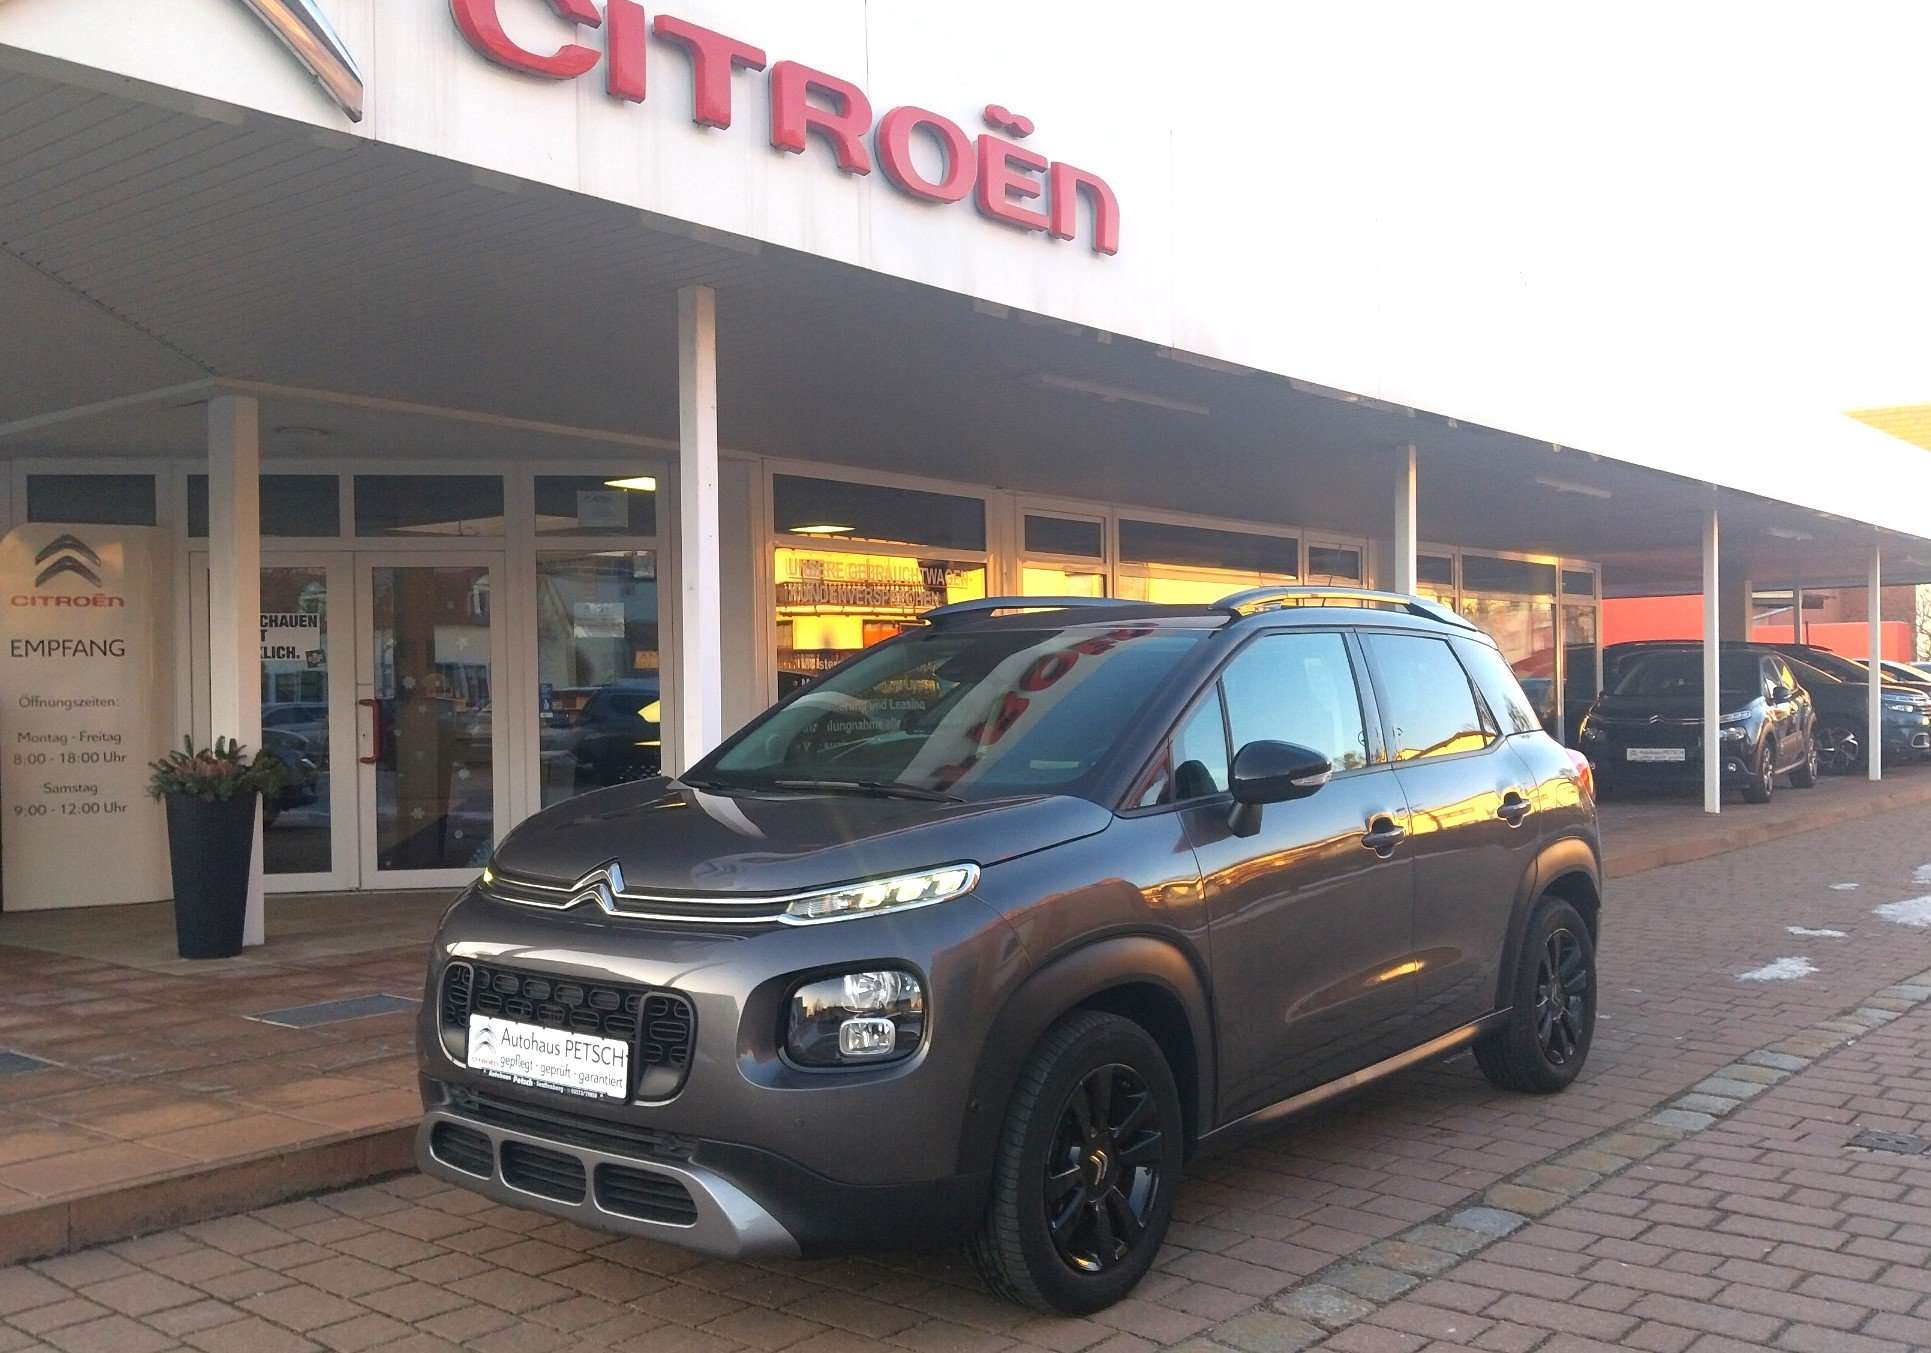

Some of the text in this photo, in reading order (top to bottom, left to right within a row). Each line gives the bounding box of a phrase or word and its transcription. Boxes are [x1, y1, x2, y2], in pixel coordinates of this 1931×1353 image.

[260, 614, 318, 628] CHAUEN
[10, 639, 126, 657] EMPFANG
[261, 646, 301, 659] LICH.
[18, 694, 120, 711] Öffnungszeiten:
[17, 732, 68, 746] Montag
[79, 730, 122, 745] Freitag
[14, 753, 47, 766] 8:00
[60, 752, 100, 764] 18:00
[103, 751, 127, 763] Uhr
[43, 782, 98, 796] Samstag
[14, 804, 47, 817] 9:00
[61, 803, 100, 816] 12:00
[104, 802, 128, 814] Uhr
[501, 1027, 624, 1068] Autohaus PETSCH
[500, 1054, 533, 1072] gepflegt
[540, 1064, 571, 1079] geprüft
[578, 1071, 623, 1089] garantiert
